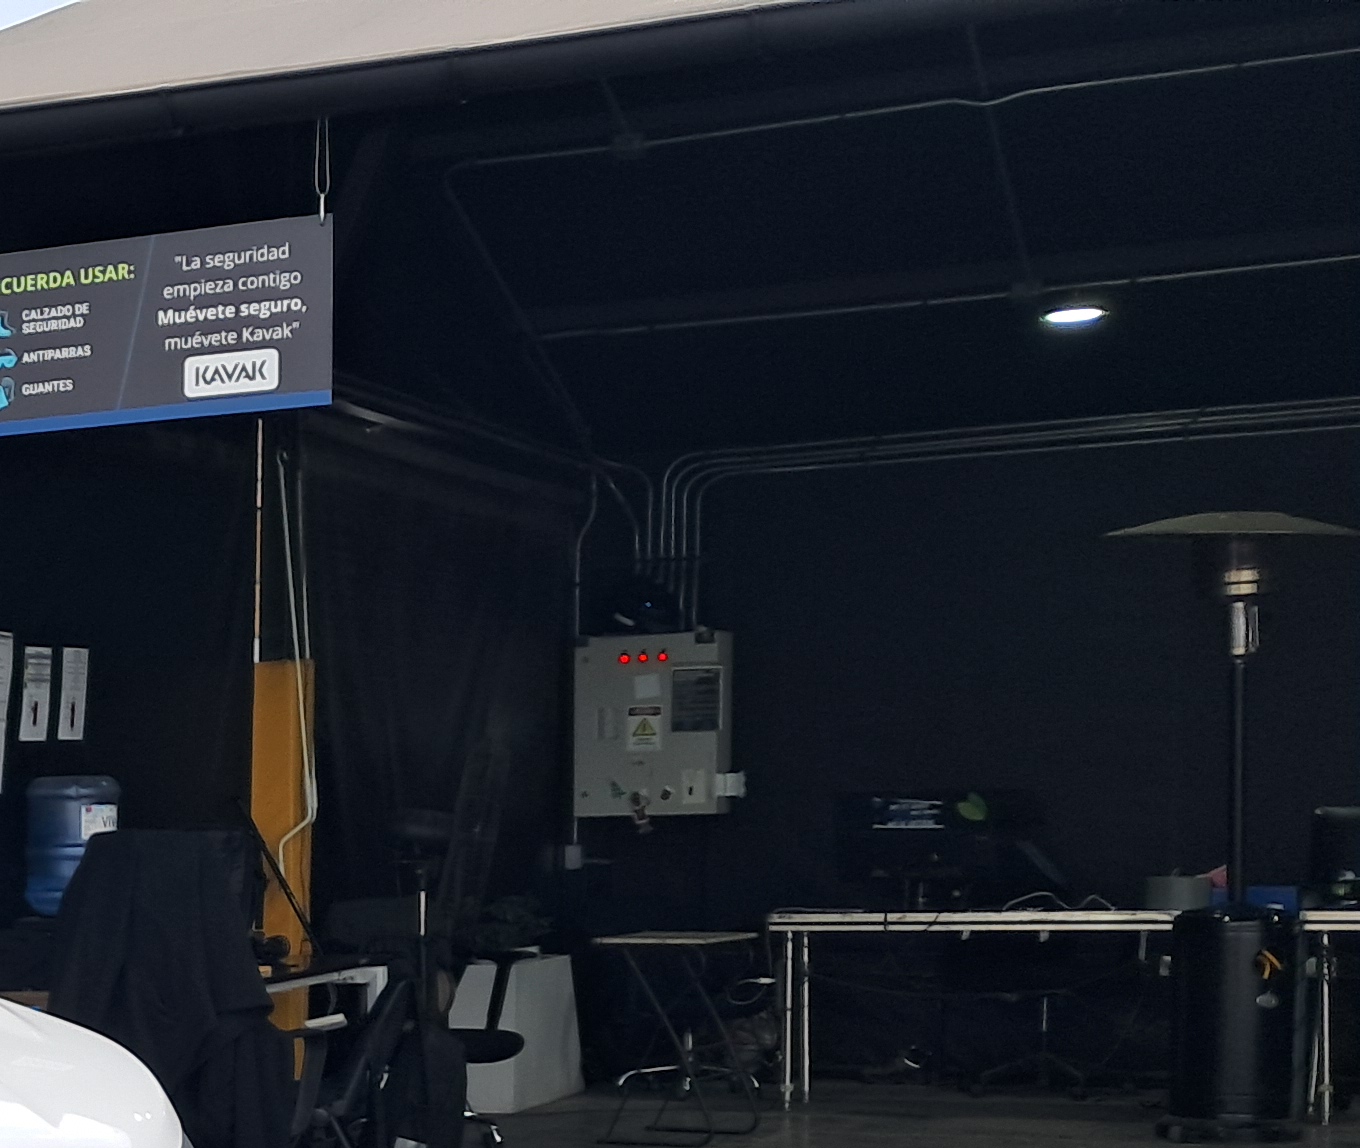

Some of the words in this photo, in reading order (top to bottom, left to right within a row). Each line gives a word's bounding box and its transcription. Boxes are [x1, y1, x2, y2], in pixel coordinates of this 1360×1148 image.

[205, 242, 290, 270] seguridad
[80, 263, 135, 284] USAR:
[163, 279, 234, 301] empieza
[238, 270, 302, 290] contigo
[21, 304, 73, 321] CALZADO
[75, 302, 90, 315] DE
[157, 303, 236, 326] Muévete
[239, 297, 308, 319] seguro,
[21, 316, 84, 334] SEGURIDAD
[164, 330, 238, 351] muévete
[21, 344, 91, 364] ANTIPARRAS
[194, 359, 267, 387] KAVAK
[21, 379, 73, 396] GUANTES
